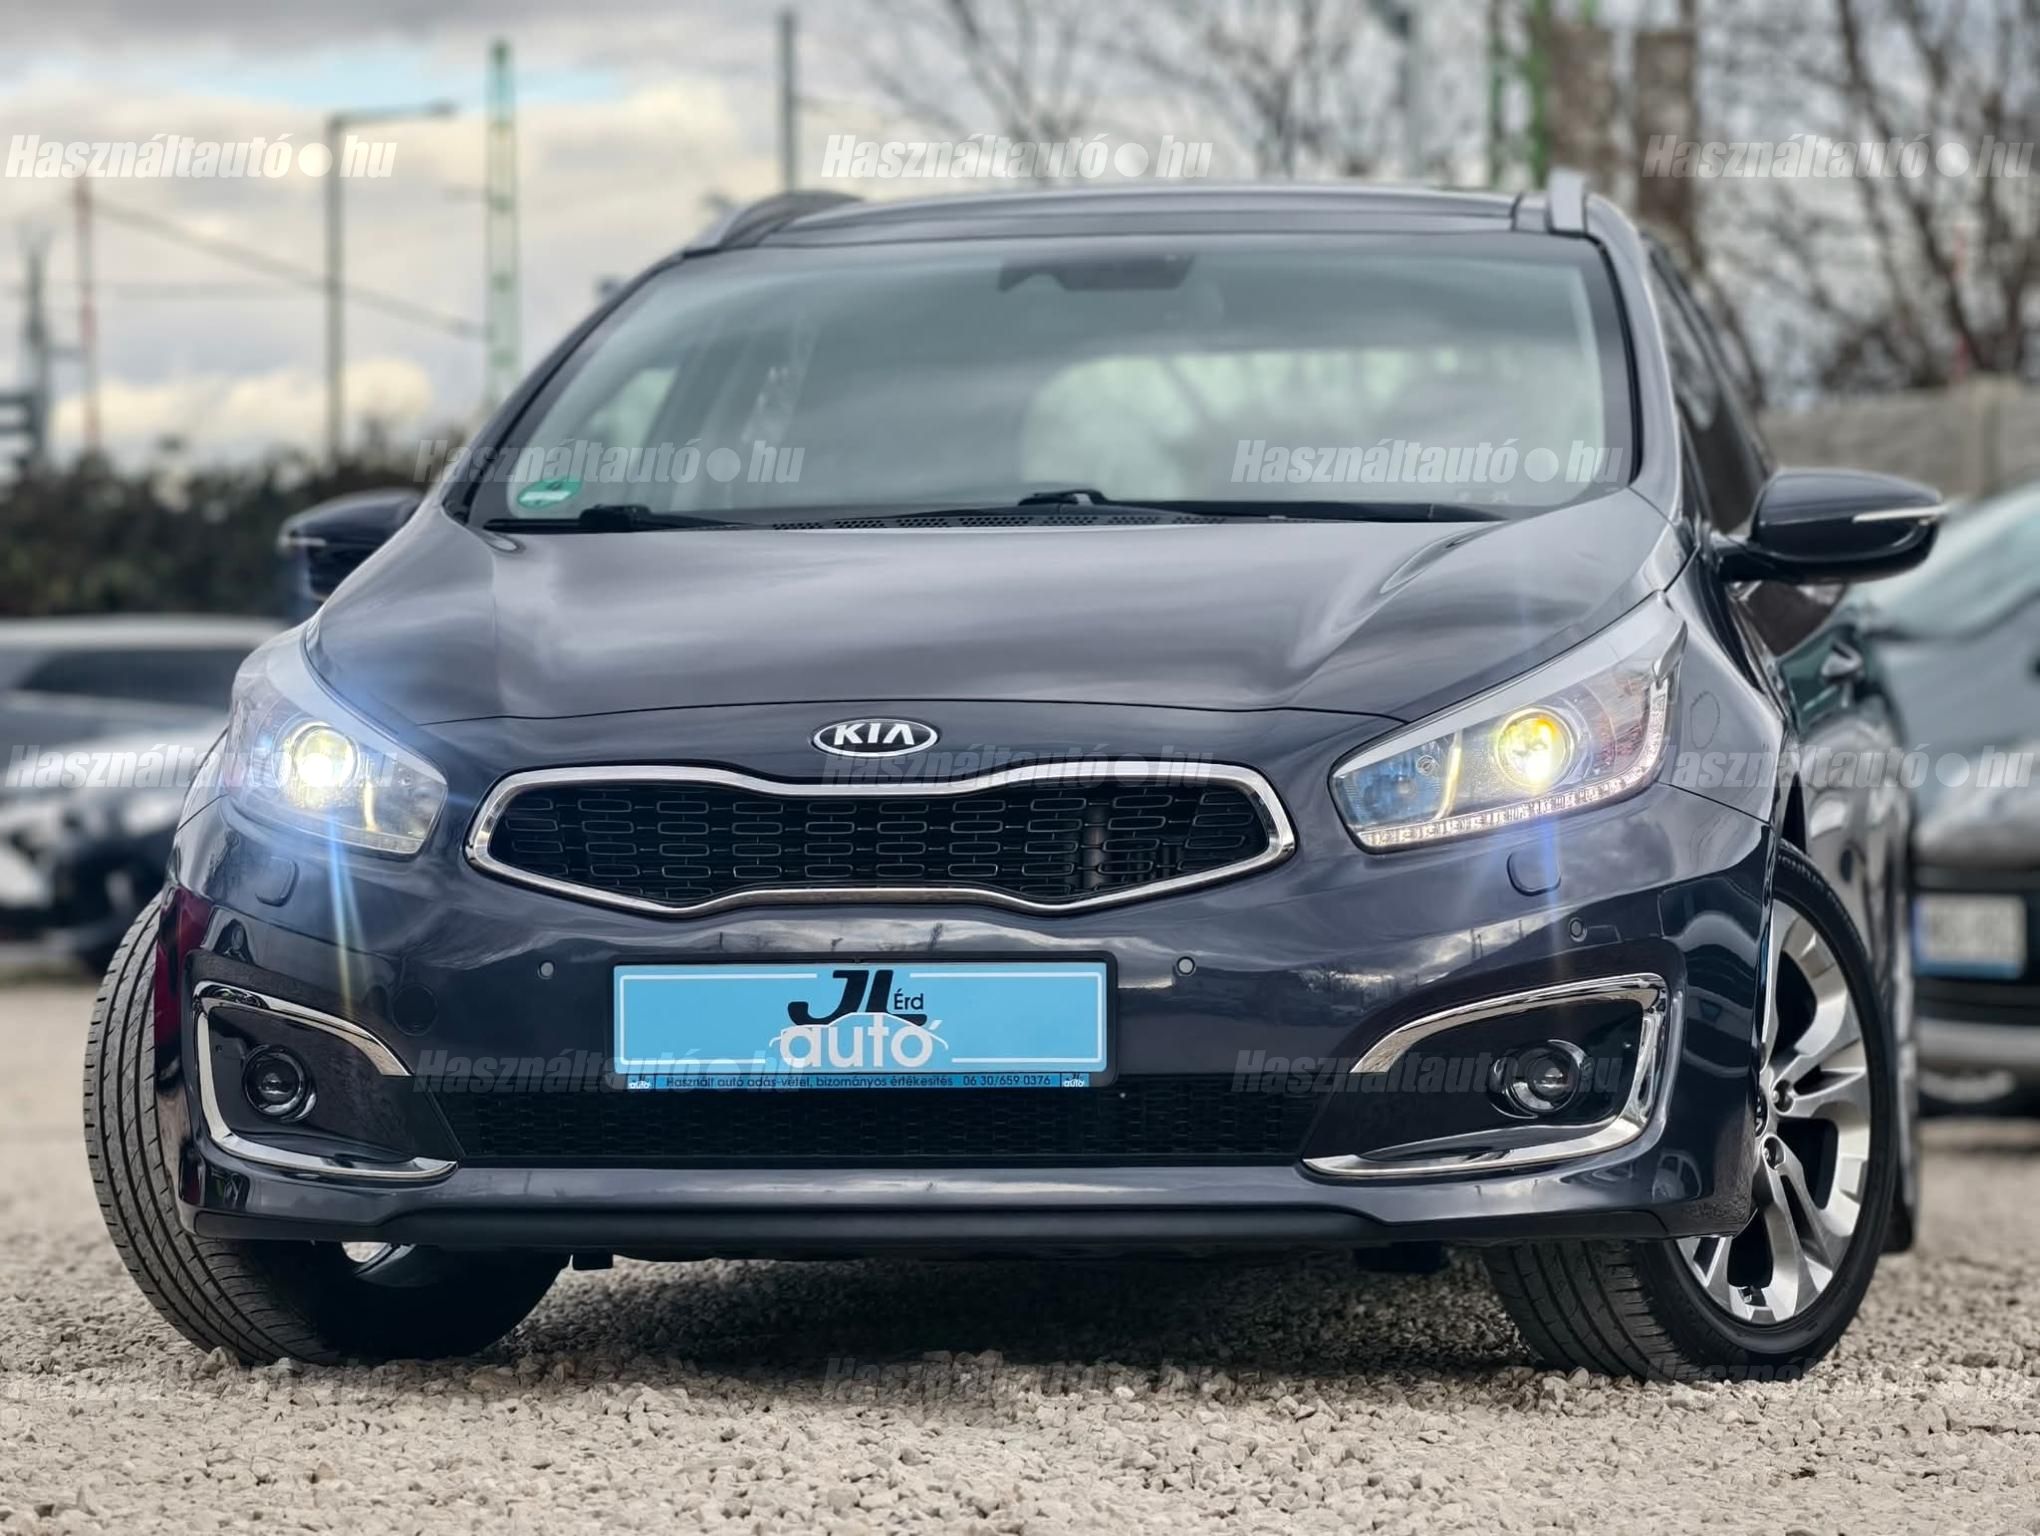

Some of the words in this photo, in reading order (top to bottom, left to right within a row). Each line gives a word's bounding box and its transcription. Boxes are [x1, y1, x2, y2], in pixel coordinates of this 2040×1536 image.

[834, 722, 915, 746] KIA
[787, 969, 928, 1027] JL
[893, 988, 925, 1011] Érd
[779, 1013, 943, 1069] autó
[717, 1074, 745, 1088] autó
[816, 1073, 888, 1090] bizományos
[889, 1072, 954, 1087] értékesítés
[962, 1074, 978, 1087] 06
[979, 1074, 1020, 1087] 30/659
[1022, 1073, 1051, 1087] 0376
